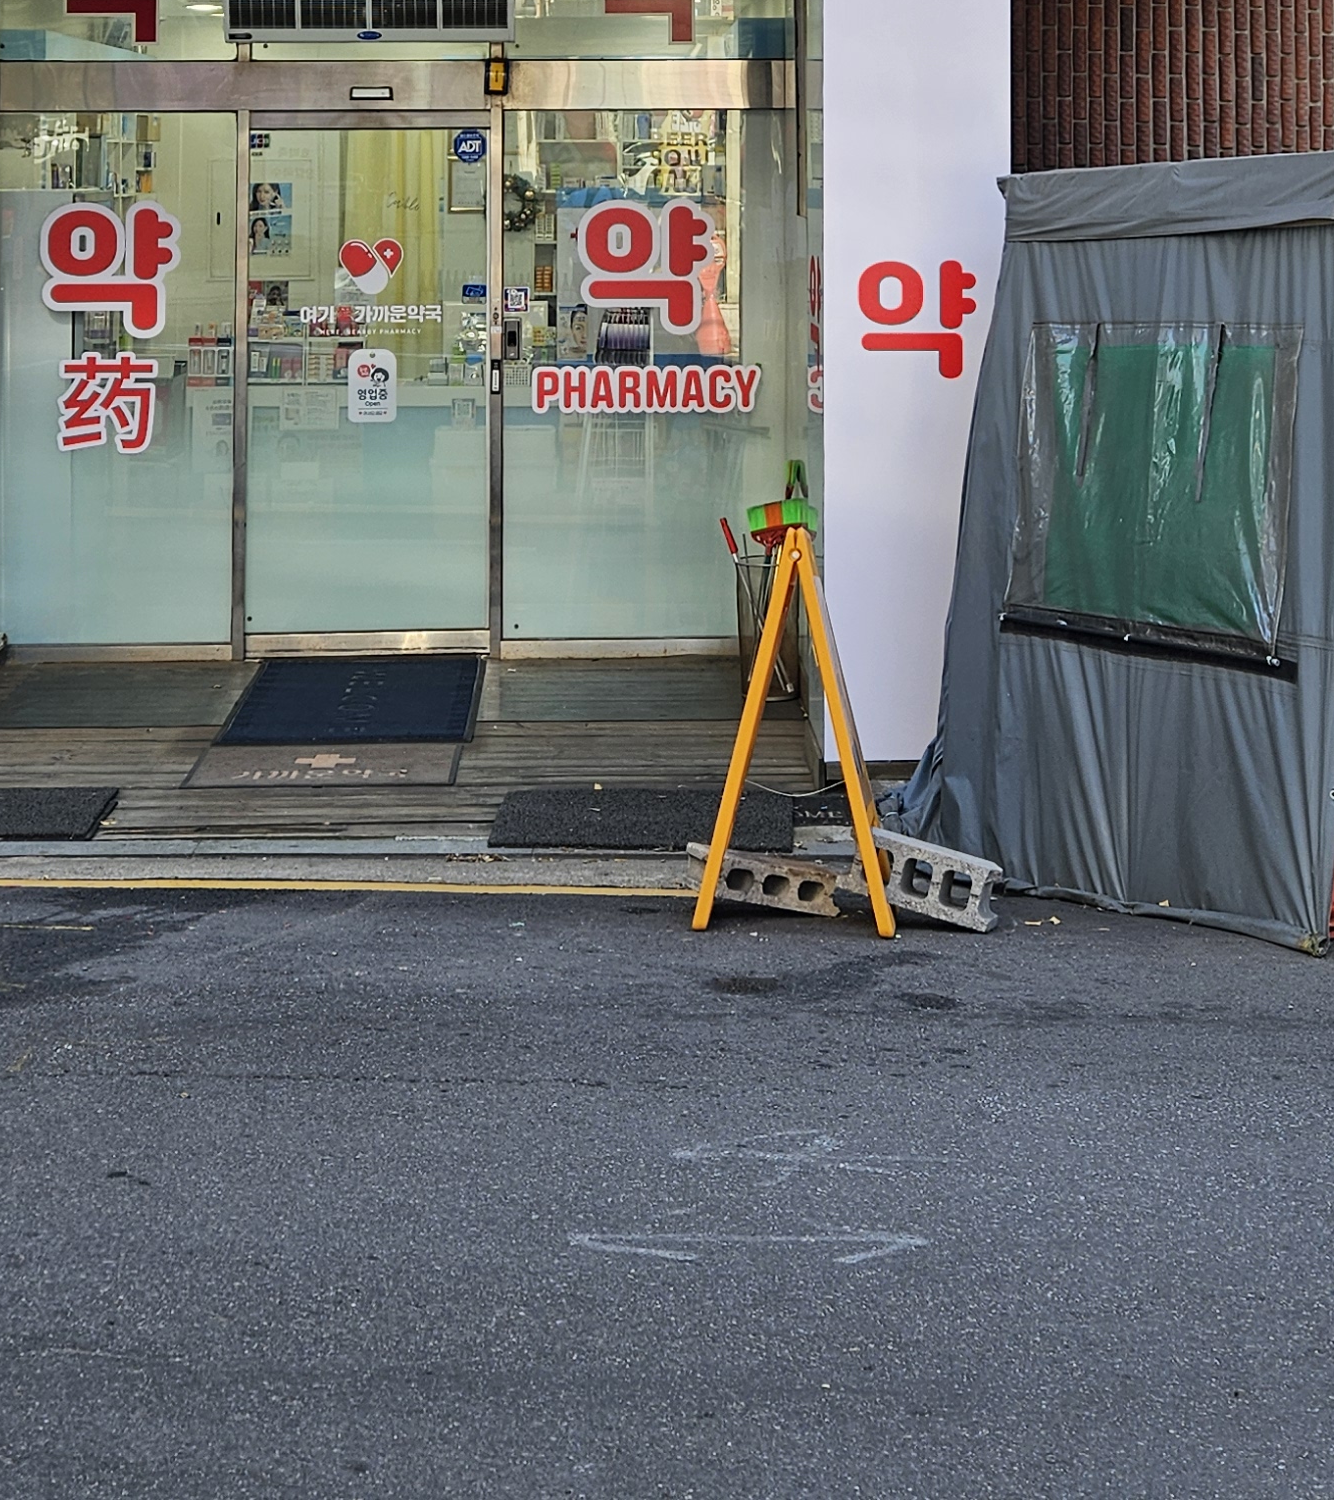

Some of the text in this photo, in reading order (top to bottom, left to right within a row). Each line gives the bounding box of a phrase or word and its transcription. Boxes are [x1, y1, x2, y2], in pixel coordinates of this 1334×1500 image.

[458, 140, 482, 153] ADT
[43, 204, 178, 336] 약
[581, 200, 712, 333] 약
[379, 328, 422, 336] PHARMACY
[857, 259, 977, 379] 약
[59, 353, 157, 453] 药
[357, 388, 389, 401] 영업중
[364, 400, 381, 408] Open
[534, 366, 760, 414] PHARMACY
